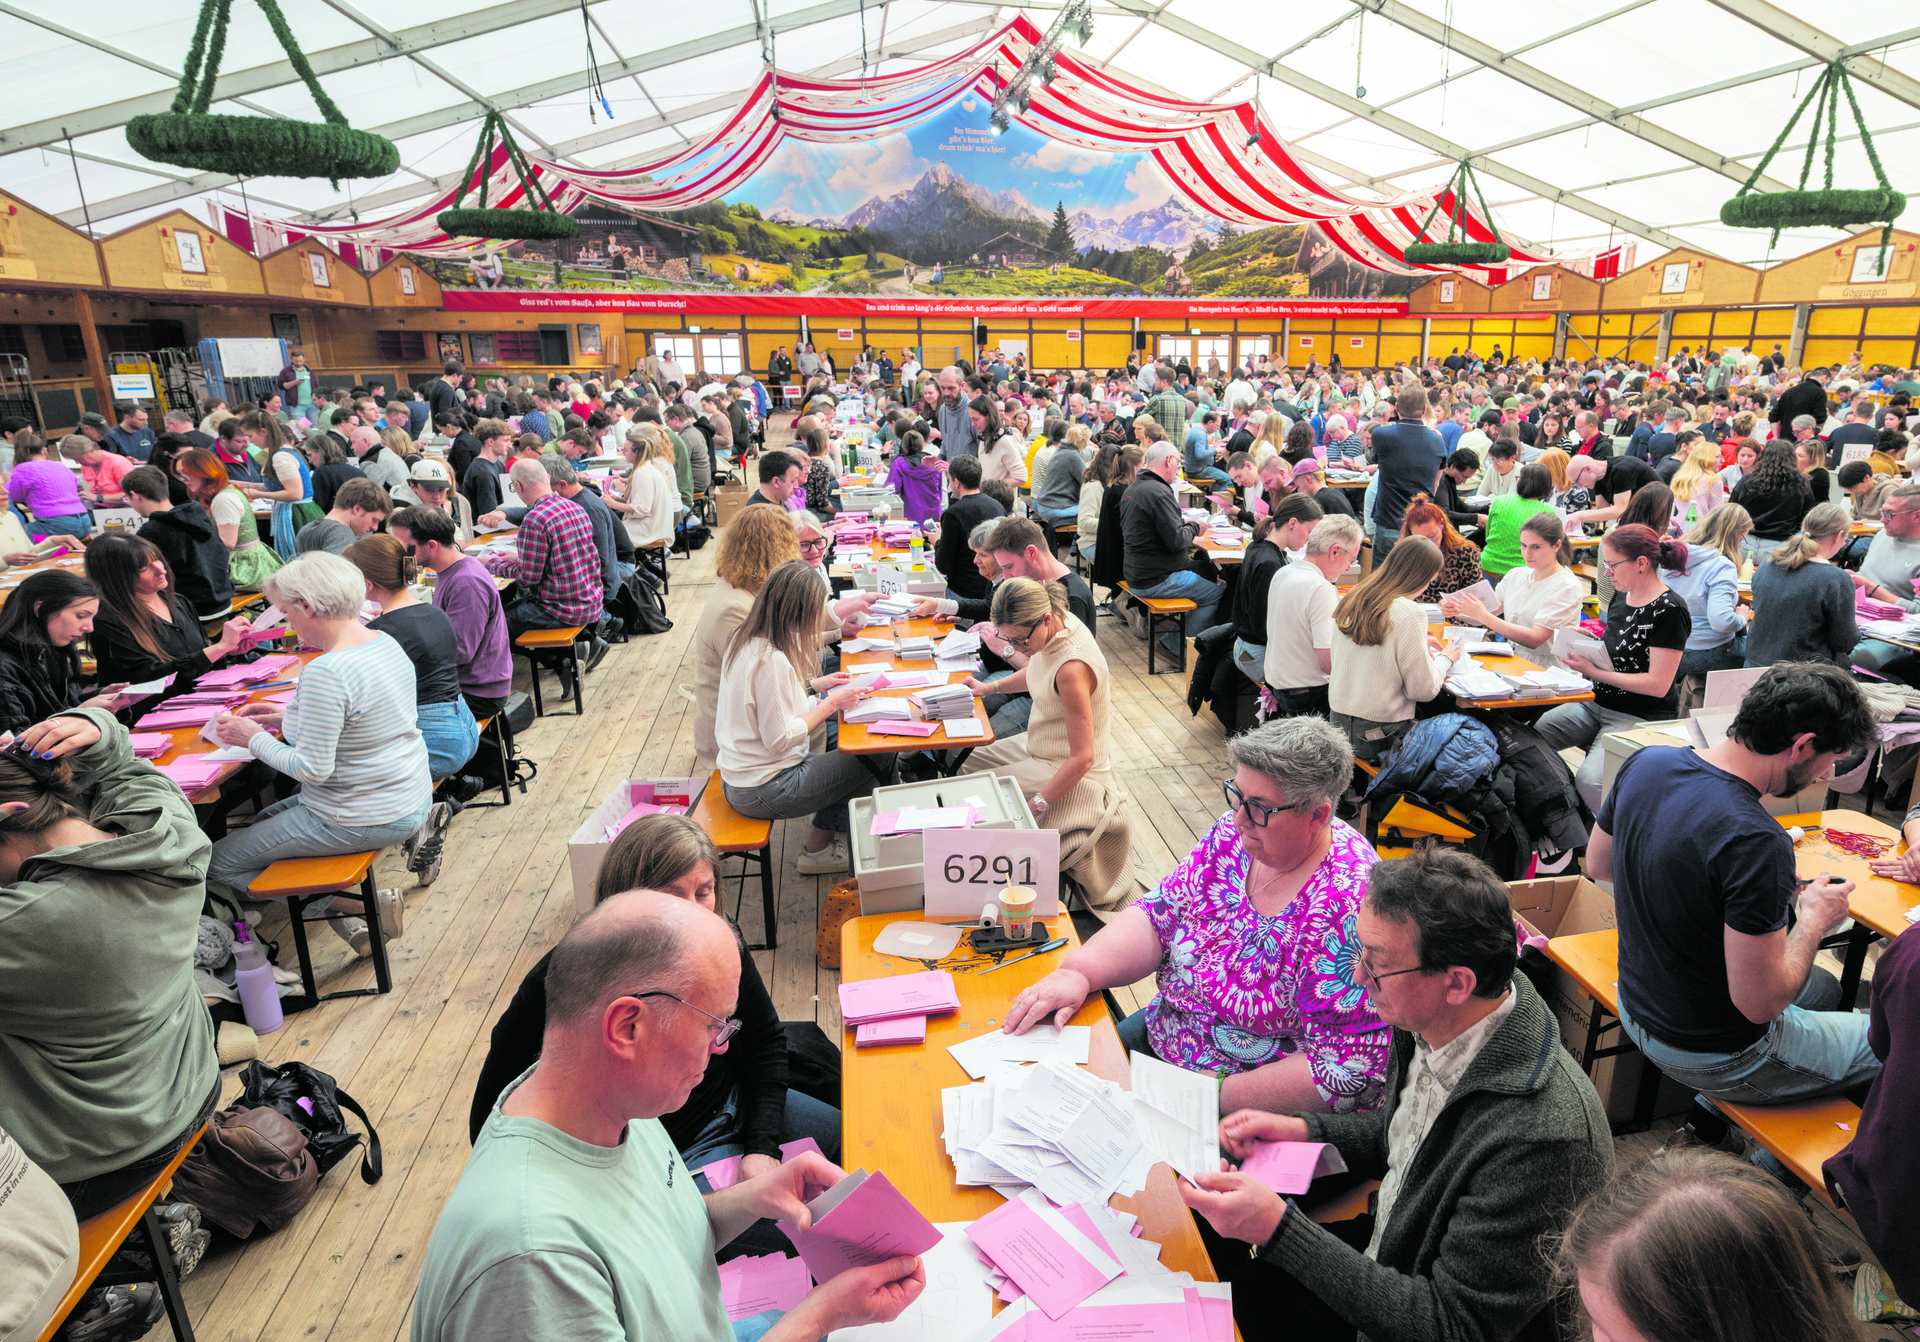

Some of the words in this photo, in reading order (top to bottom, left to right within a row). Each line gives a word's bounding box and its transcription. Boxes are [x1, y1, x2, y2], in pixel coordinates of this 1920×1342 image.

[1842, 288, 1888, 299] Göggingen
[572, 299, 594, 307] Saufa,
[658, 300, 686, 308] Durscht!
[1658, 296, 1684, 305] Hochzoll
[916, 304, 933, 312] lang's
[1846, 450, 1867, 459] 6185
[944, 854, 1037, 885] 6291
[10, 1177, 19, 1189] in
